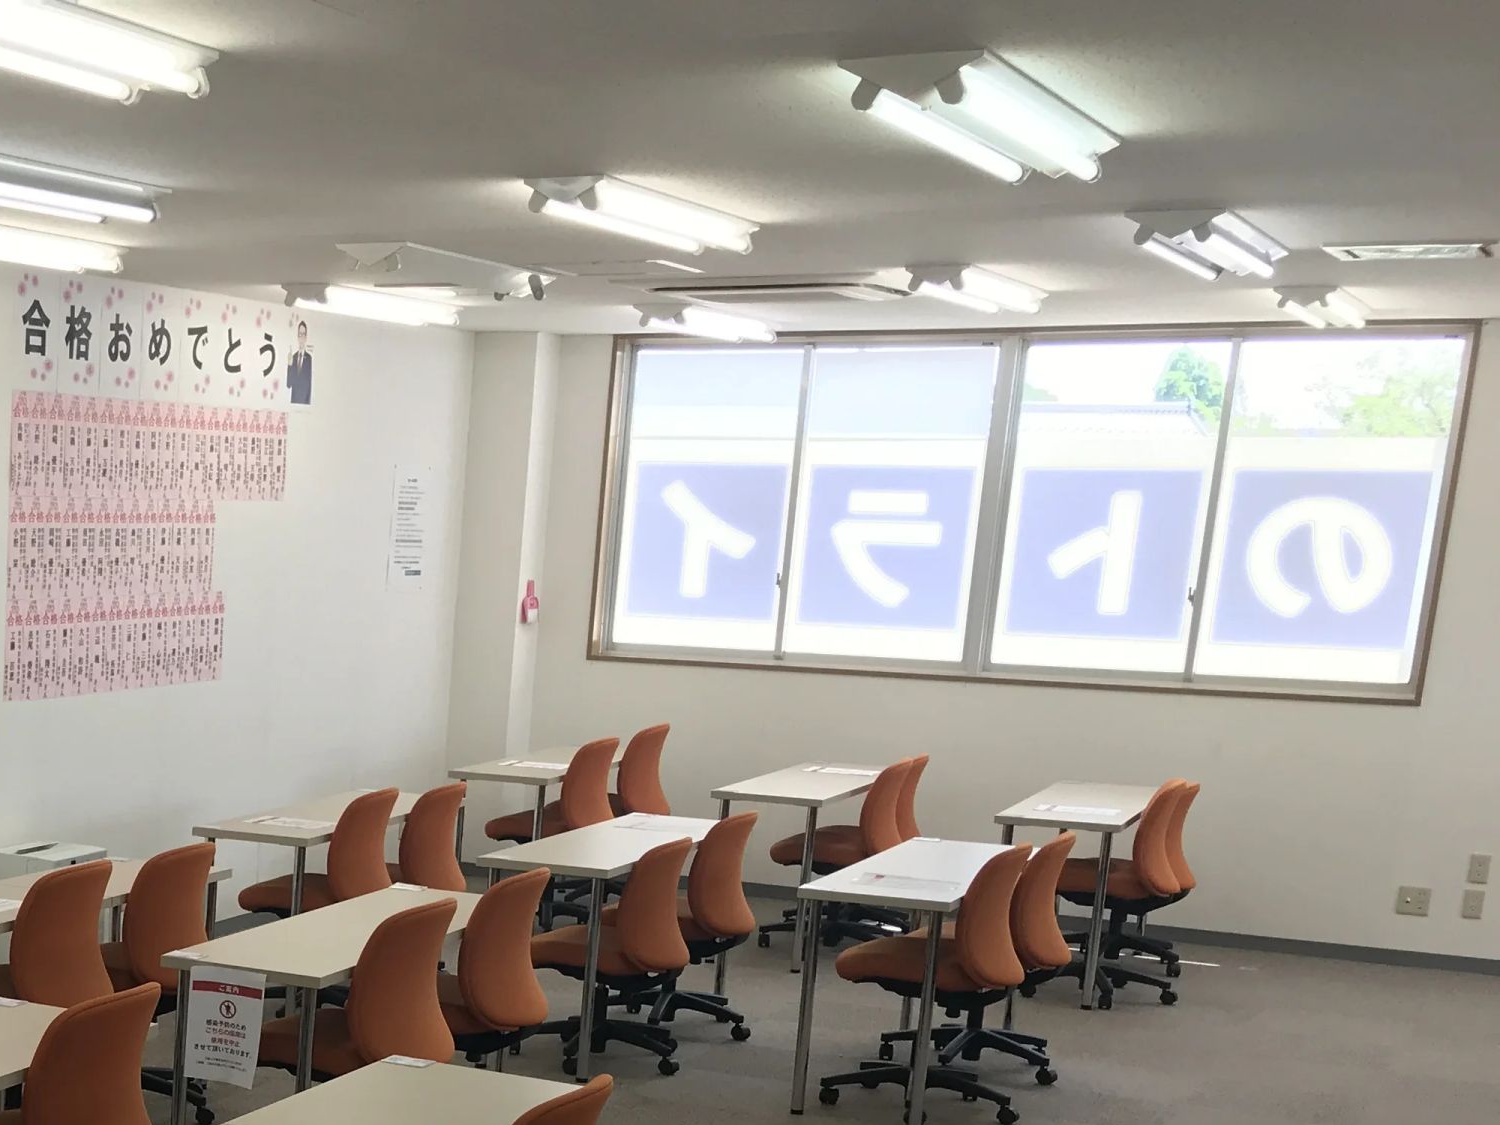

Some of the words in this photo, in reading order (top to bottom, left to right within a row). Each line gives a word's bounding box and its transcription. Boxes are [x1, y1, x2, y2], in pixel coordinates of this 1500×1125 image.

[22, 299, 277, 377] 合格おめでとう
